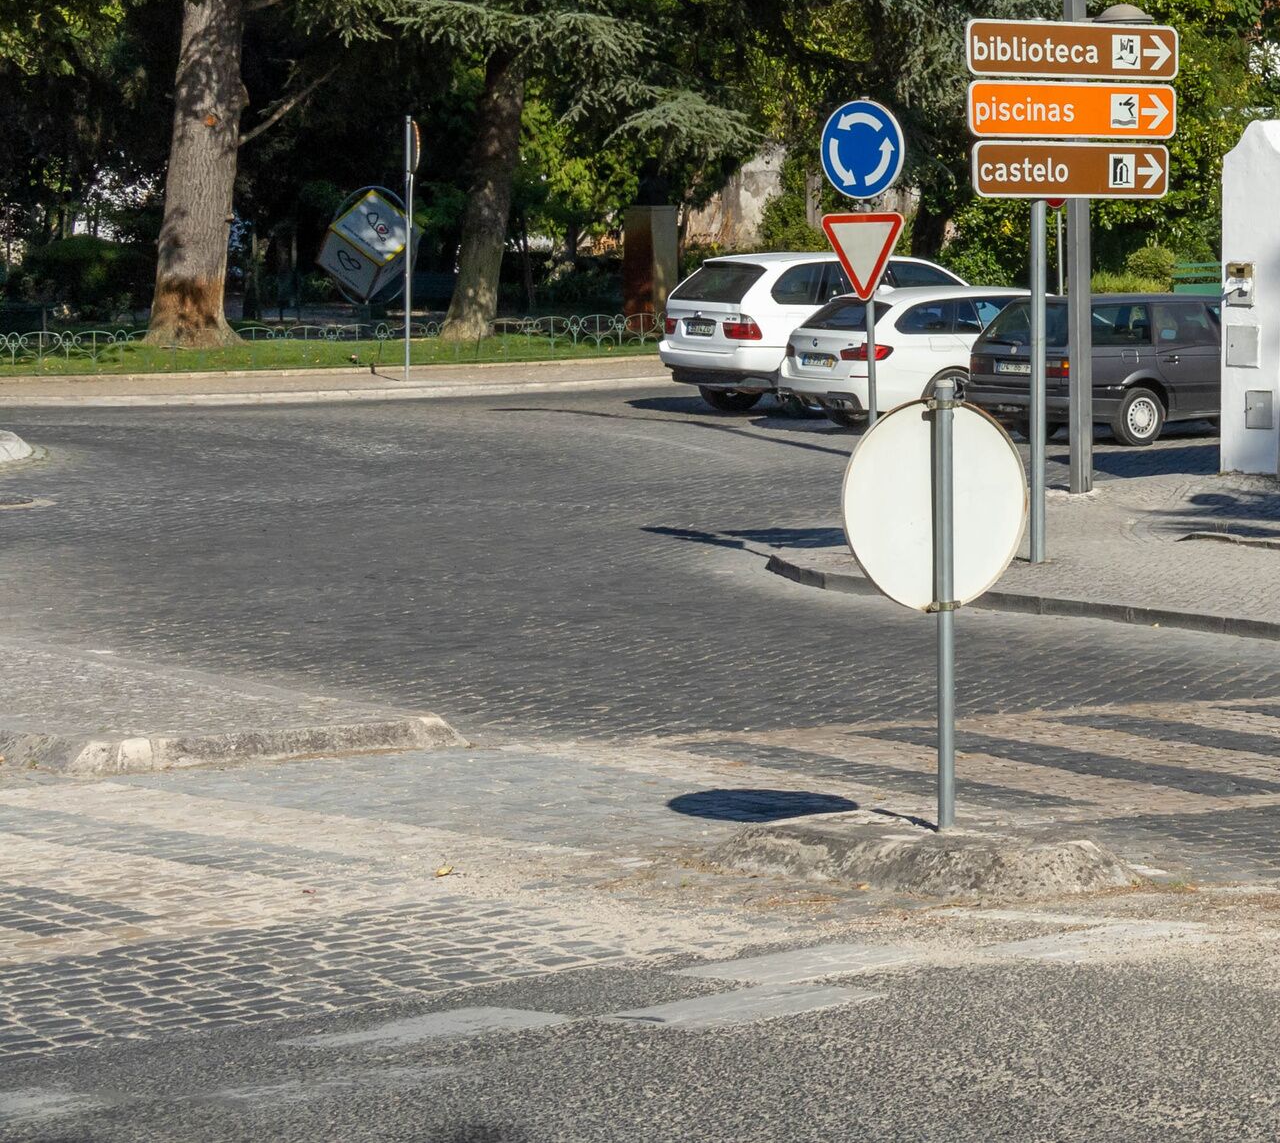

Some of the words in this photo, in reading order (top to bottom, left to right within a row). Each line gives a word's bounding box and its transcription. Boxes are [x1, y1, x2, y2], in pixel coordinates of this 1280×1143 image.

[974, 36, 1099, 64] biblioteca
[976, 97, 1075, 125] piscinas
[980, 158, 1069, 183] castelo
